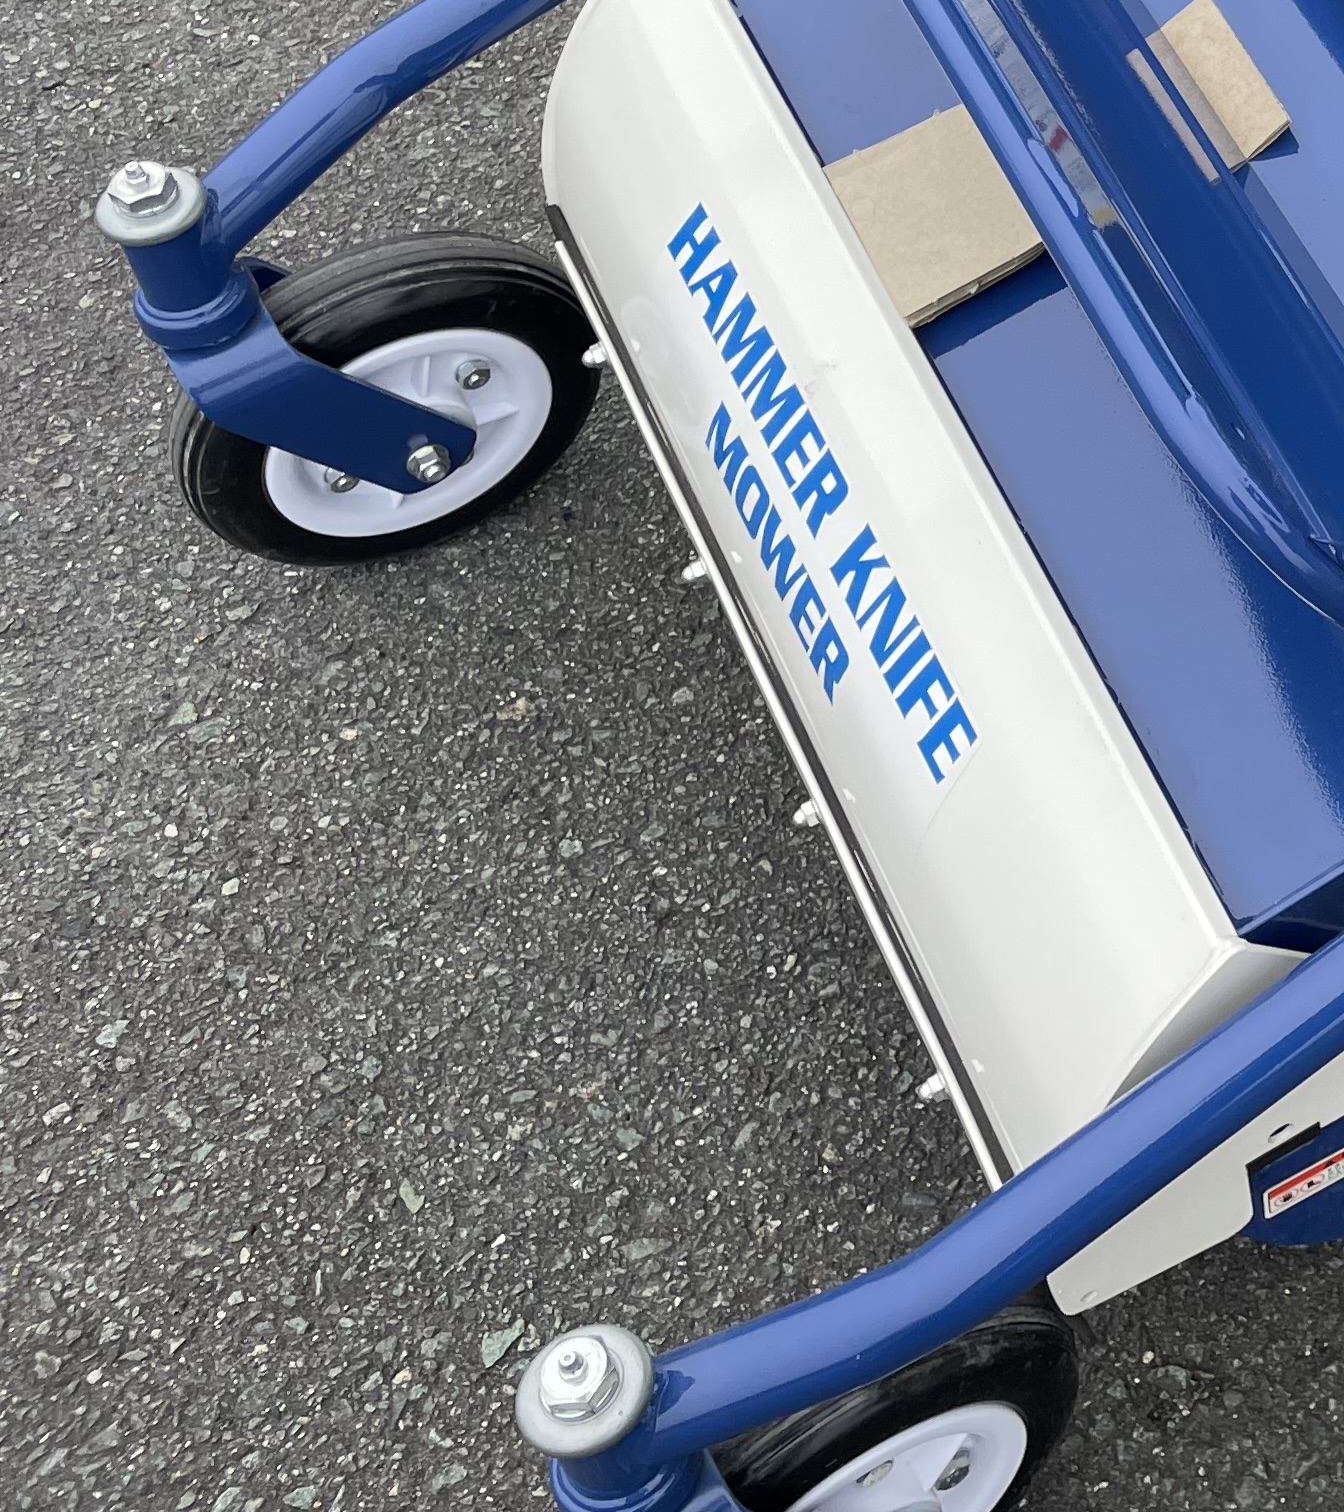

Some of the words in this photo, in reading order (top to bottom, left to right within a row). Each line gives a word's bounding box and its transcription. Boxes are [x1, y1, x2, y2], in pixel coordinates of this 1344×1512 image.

[666, 201, 851, 540] HAMMER
[830, 522, 979, 785] KNIFE
[706, 400, 851, 707] MOWER
